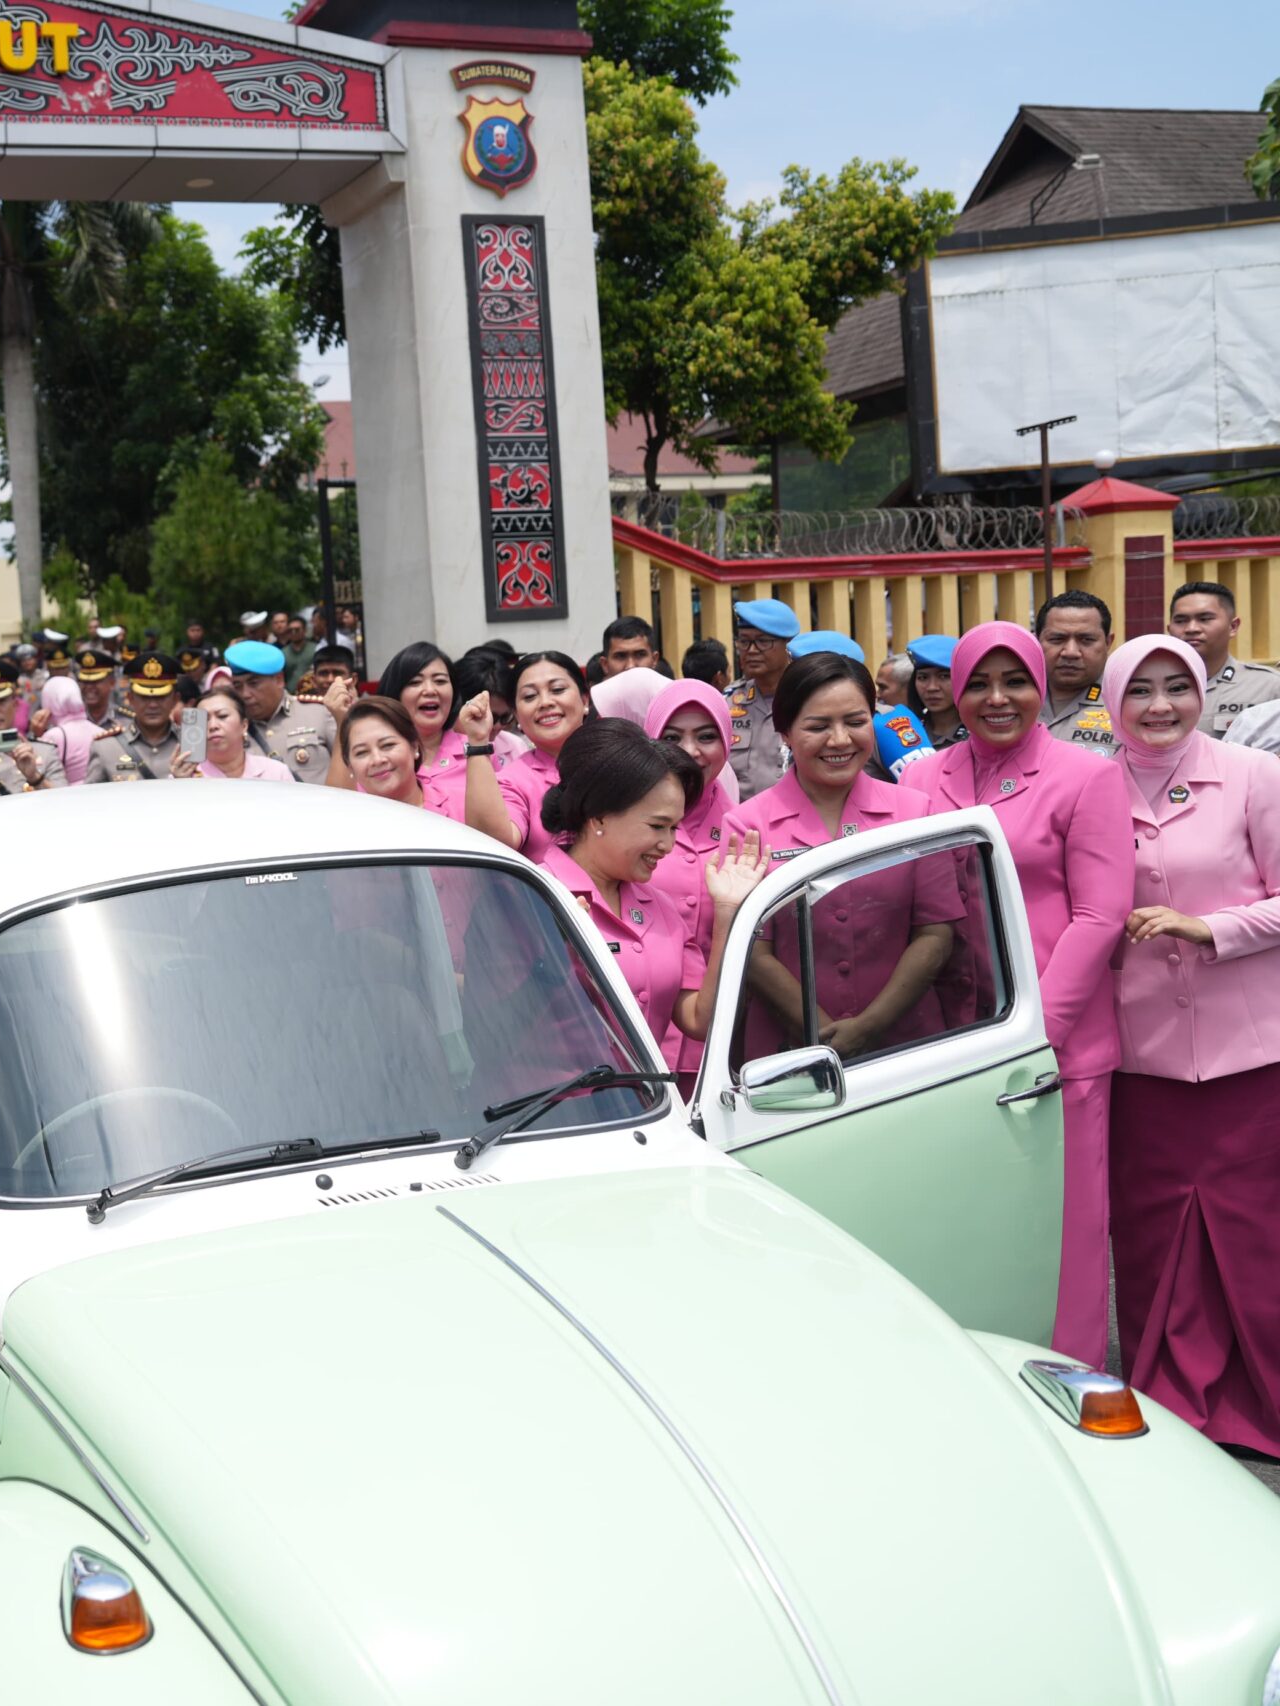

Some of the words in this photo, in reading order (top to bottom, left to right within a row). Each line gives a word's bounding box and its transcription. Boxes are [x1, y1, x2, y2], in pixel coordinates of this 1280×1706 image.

[458, 65, 502, 81] SUMATERA
[503, 66, 531, 84] UTARA
[1071, 730, 1114, 744] POLRI
